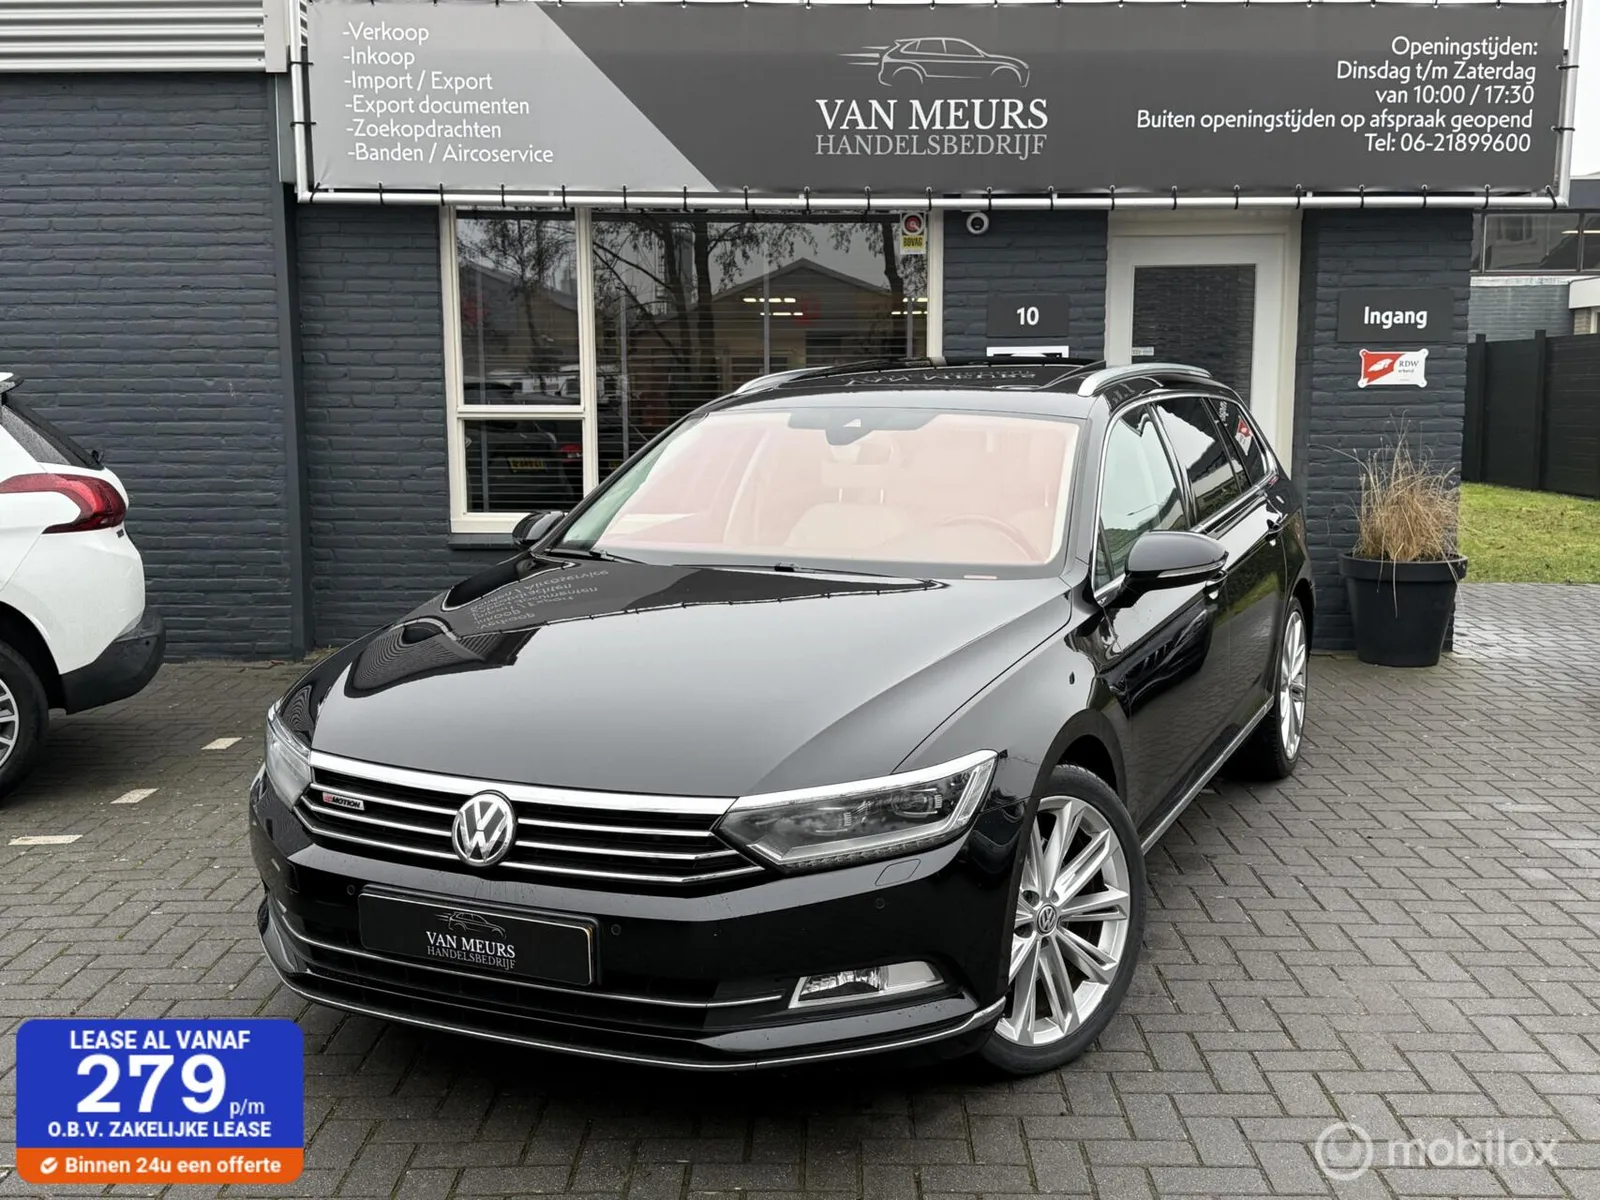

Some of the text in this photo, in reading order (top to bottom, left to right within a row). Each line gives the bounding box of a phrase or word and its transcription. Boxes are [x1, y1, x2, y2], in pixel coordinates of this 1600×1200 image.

[343, 21, 429, 45] -Verkoop
[343, 46, 415, 70] -Inkoop
[1392, 36, 1537, 59] Openingstijden:
[344, 70, 492, 93] -Import / Export
[1338, 59, 1535, 84] Dinsdag t/m Zaterdag
[345, 95, 529, 117] -Export documenten
[1376, 84, 1534, 105] van 10:00 / 17:30
[816, 99, 1047, 130] VAN MEURS
[1138, 109, 1532, 132] Buiten openingstijden op afspraak geopend
[347, 119, 501, 142] -Zoekopdrachten
[1365, 131, 1530, 151] Tel: 06-21899600
[348, 142, 553, 163] -Banden / Aircoservice
[816, 134, 1047, 160] HANDELSBEDRIJF
[903, 237, 923, 247] BOVAG
[1017, 307, 1039, 325] 10
[1364, 306, 1427, 329] Ingang
[426, 931, 516, 958] VAN MEURS
[427, 945, 516, 970] HANDELSBEDRIJF
